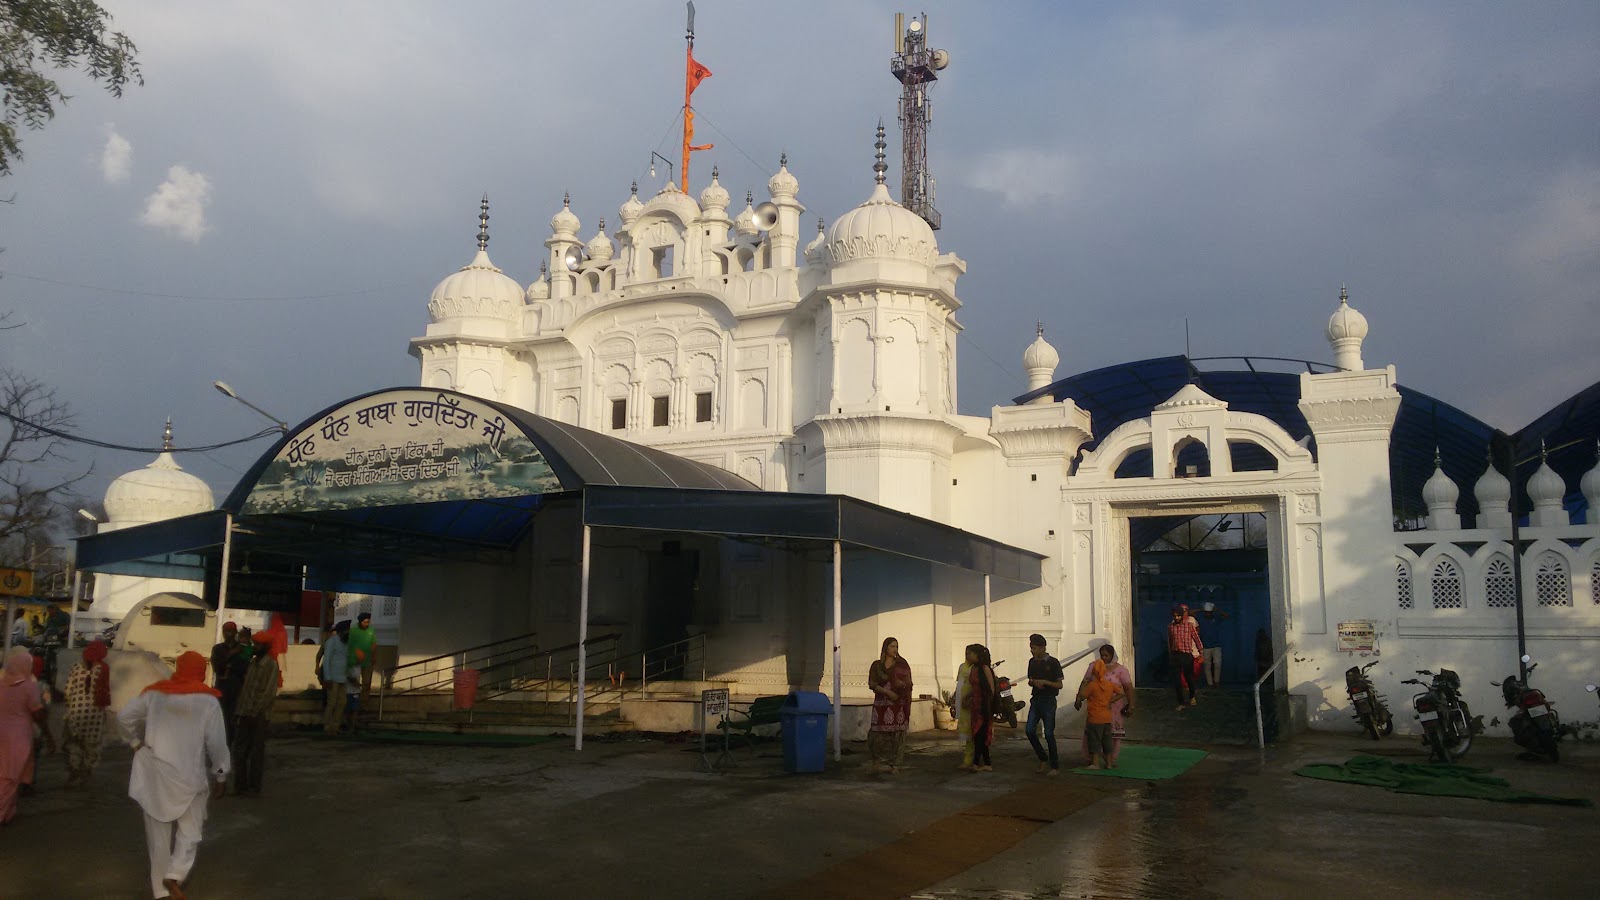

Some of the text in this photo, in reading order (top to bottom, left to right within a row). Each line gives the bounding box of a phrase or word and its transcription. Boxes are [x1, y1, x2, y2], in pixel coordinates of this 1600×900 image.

[287, 393, 506, 463] ਧੰਨ ਧੰਨ ਬਾਬਾ ਗੁਰਦਿੱਤਾ ਜੀ
[345, 447, 364, 465] ਦੀਨ
[368, 443, 387, 465] ਦੁਨੀ
[390, 447, 402, 460] ਦਾ
[432, 437, 444, 456] ਜੀ
[336, 471, 351, 486] ਵਰ
[400, 465, 418, 480] ਵਰ
[446, 456, 460, 477] ਜੀ
